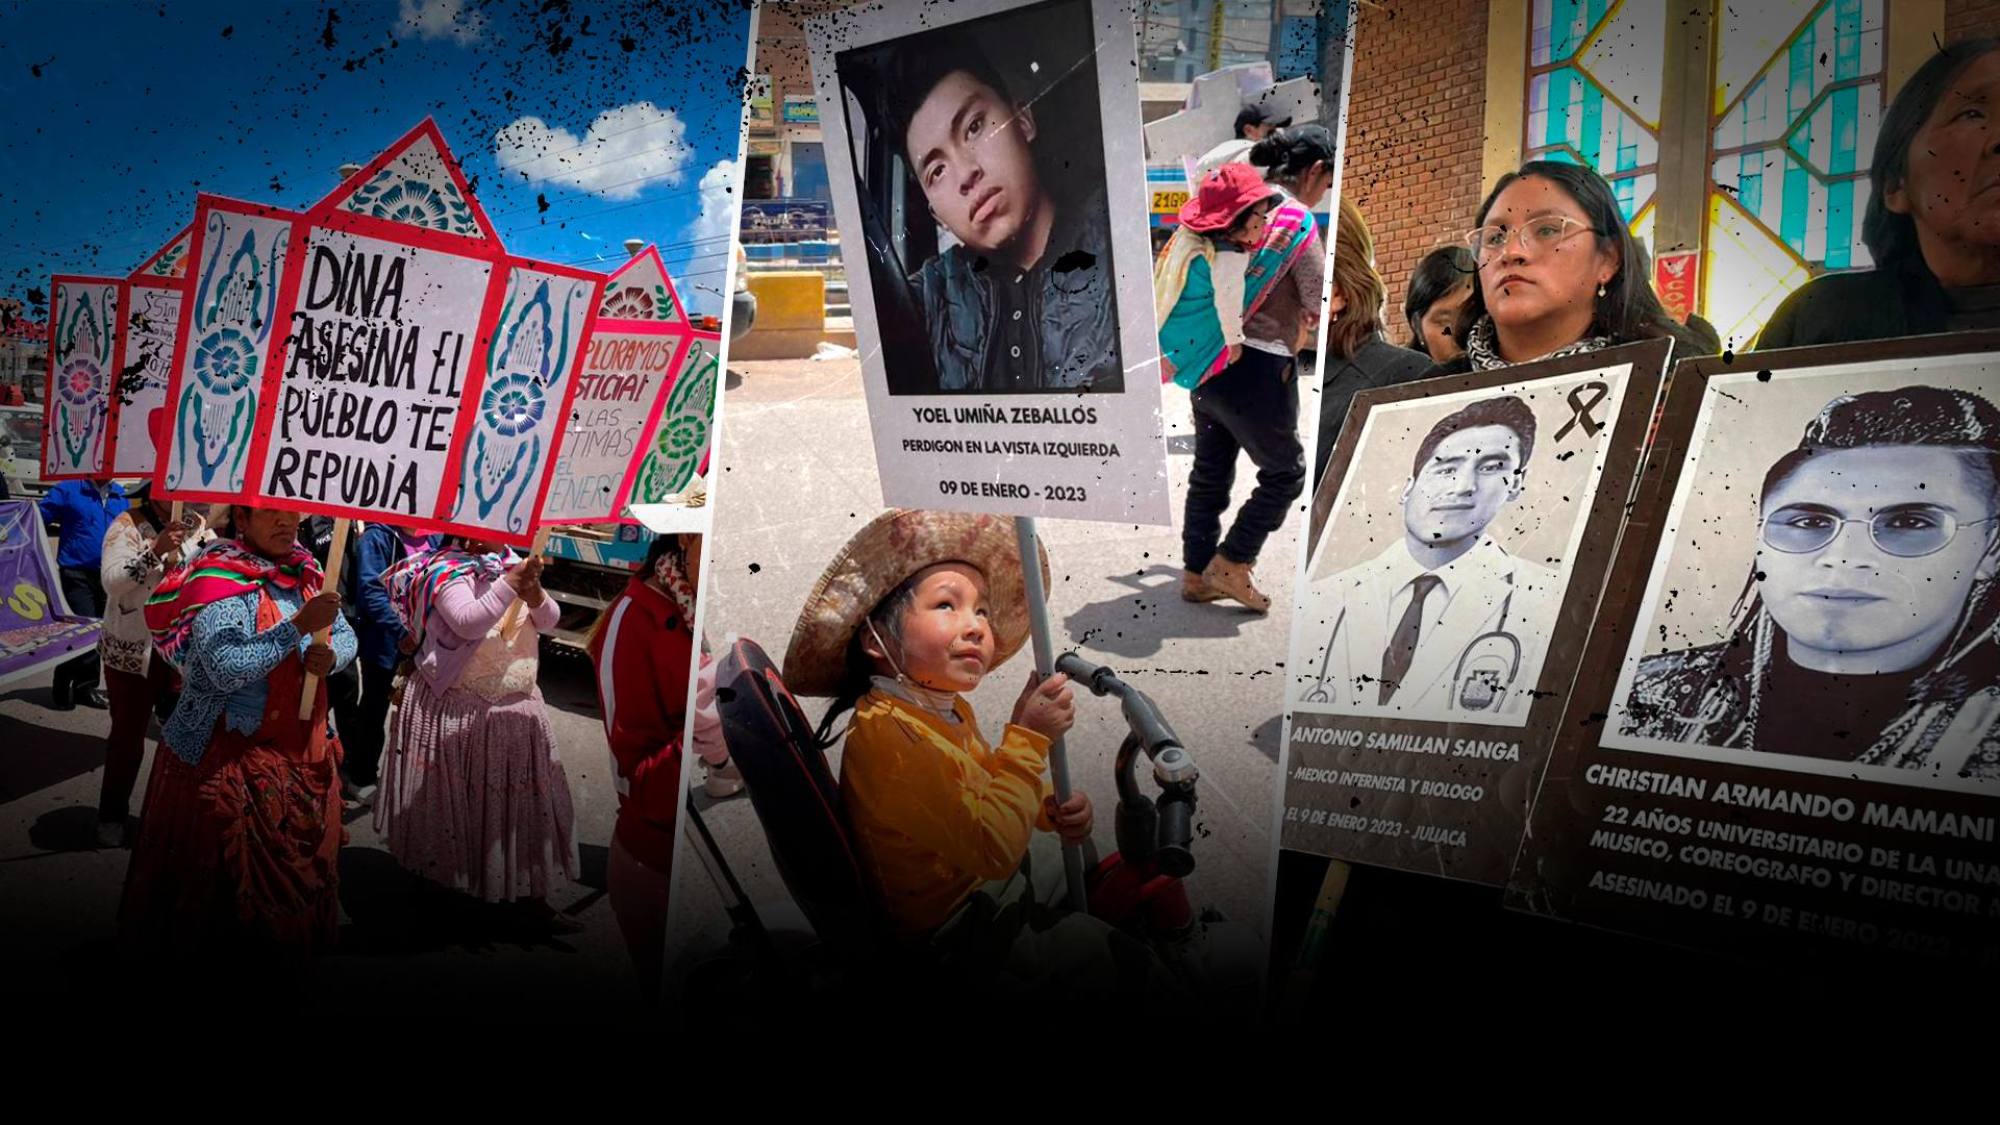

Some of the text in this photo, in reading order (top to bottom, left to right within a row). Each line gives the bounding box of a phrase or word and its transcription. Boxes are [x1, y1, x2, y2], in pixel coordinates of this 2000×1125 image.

[306, 246, 406, 320] DINA
[286, 317, 464, 398] ASESINA EL
[281, 384, 454, 452] PUEBLO TE
[585, 408, 623, 428] LAS
[912, 407, 951, 424] YOEL
[955, 403, 1008, 424] UMIÑA
[902, 439, 1121, 458] PERDIGON EN LA VISTA IZQUIERDA
[268, 447, 418, 515] REPUDIA
[940, 480, 957, 496] 09
[961, 482, 979, 497] DE
[981, 483, 1030, 499] ENERO
[1044, 486, 1087, 502] 2023
[1290, 727, 1520, 763] ANTONIO SAMILLAN SANGA
[1294, 767, 1338, 784] MEDICO
[1339, 772, 1405, 793] INTERNISTA
[1410, 778, 1421, 794] Y
[1420, 781, 1485, 803] BIOLOGO
[1585, 763, 1996, 844] CHRISTIAN ARMANDO MAMANI
[1286, 806, 1298, 823] EL
[1300, 809, 1309, 823] 9
[1310, 810, 1326, 826] DE
[1327, 813, 1369, 832] ENERO
[1370, 817, 1403, 837] 2023
[1411, 824, 1468, 848] JULIACA
[1602, 803, 1631, 825] 22
[1631, 807, 1694, 836] AÑOS
[1696, 819, 1865, 865] UNIVERSITARIO
[1869, 846, 1902, 871] DE
[1906, 852, 1937, 877] LA
[1587, 869, 1710, 911] ASESINADO
[1711, 893, 1736, 918] EL
[1740, 900, 1758, 921] 9
[1761, 903, 1794, 929] DE
[1589, 828, 1674, 863] MUSICO,
[1678, 843, 1833, 890] COREOGRAFO
[1838, 871, 1858, 893] Y
[1858, 875, 1983, 920] DIRECTOR
